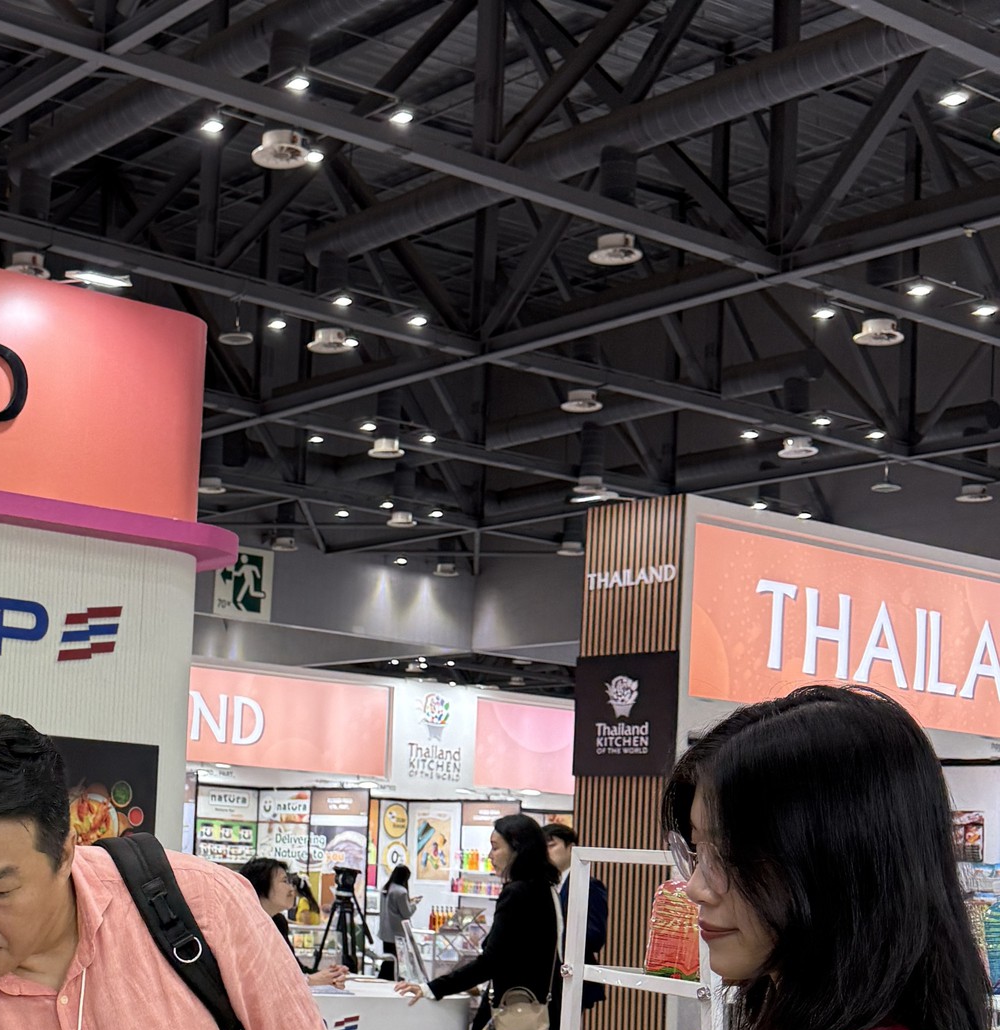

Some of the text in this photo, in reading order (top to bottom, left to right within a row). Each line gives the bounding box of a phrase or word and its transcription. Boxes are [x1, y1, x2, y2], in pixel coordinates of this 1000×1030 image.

[587, 564, 676, 591] THAILAND
[595, 721, 649, 737] Thailand
[596, 736, 649, 747] KITCHEN
[408, 742, 461, 761] Thailand
[409, 758, 461, 773] KITCHEN
[275, 832, 325, 846] Delivering
